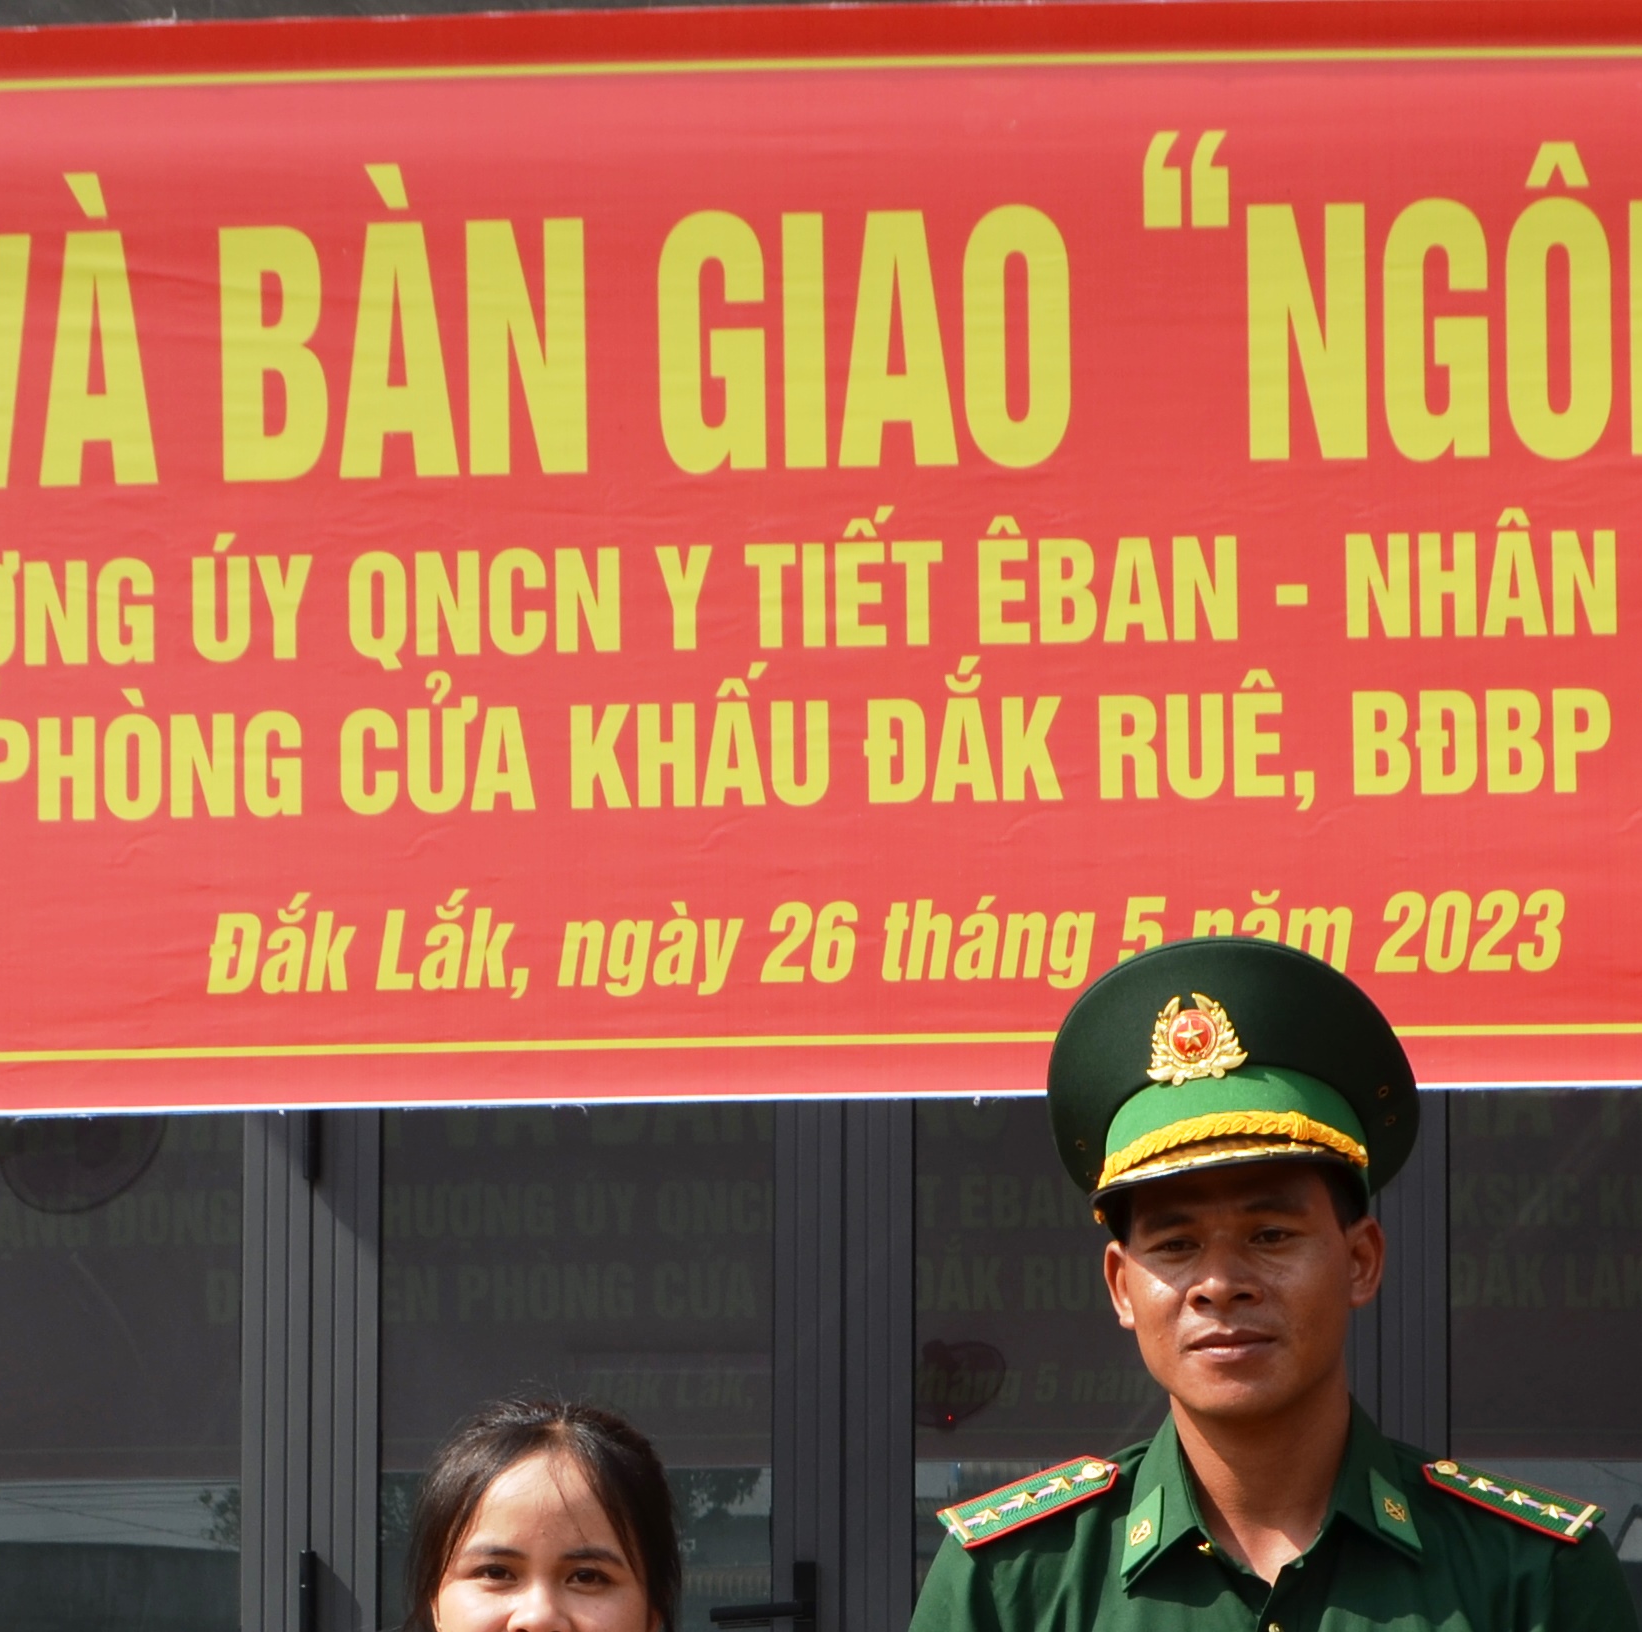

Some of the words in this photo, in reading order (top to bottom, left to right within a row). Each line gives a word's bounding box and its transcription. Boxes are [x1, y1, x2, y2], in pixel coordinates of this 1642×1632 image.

[220, 165, 587, 481] BÀN
[659, 205, 1071, 473] GIAO
[193, 534, 312, 662] ÚY
[349, 546, 620, 669] QNCN
[656, 546, 711, 649] Y
[745, 507, 942, 647] TIẾT
[978, 516, 1238, 644] ÊBAN
[1277, 585, 1308, 605] -
[1346, 508, 1617, 637] NHÂN
[341, 671, 535, 814] CỬA
[571, 662, 829, 809] KHẤU
[864, 656, 1062, 803] ĐẮK
[1099, 669, 1315, 810] RUÊ,
[1353, 689, 1611, 795] BĐBP
[208, 893, 355, 993] Đắk
[377, 889, 528, 998] Lắk,
[558, 902, 743, 996] ngày
[761, 901, 858, 983] 26
[882, 896, 1095, 988] tháng
[1116, 896, 1166, 966] 5
[1376, 889, 1565, 972] 2023
